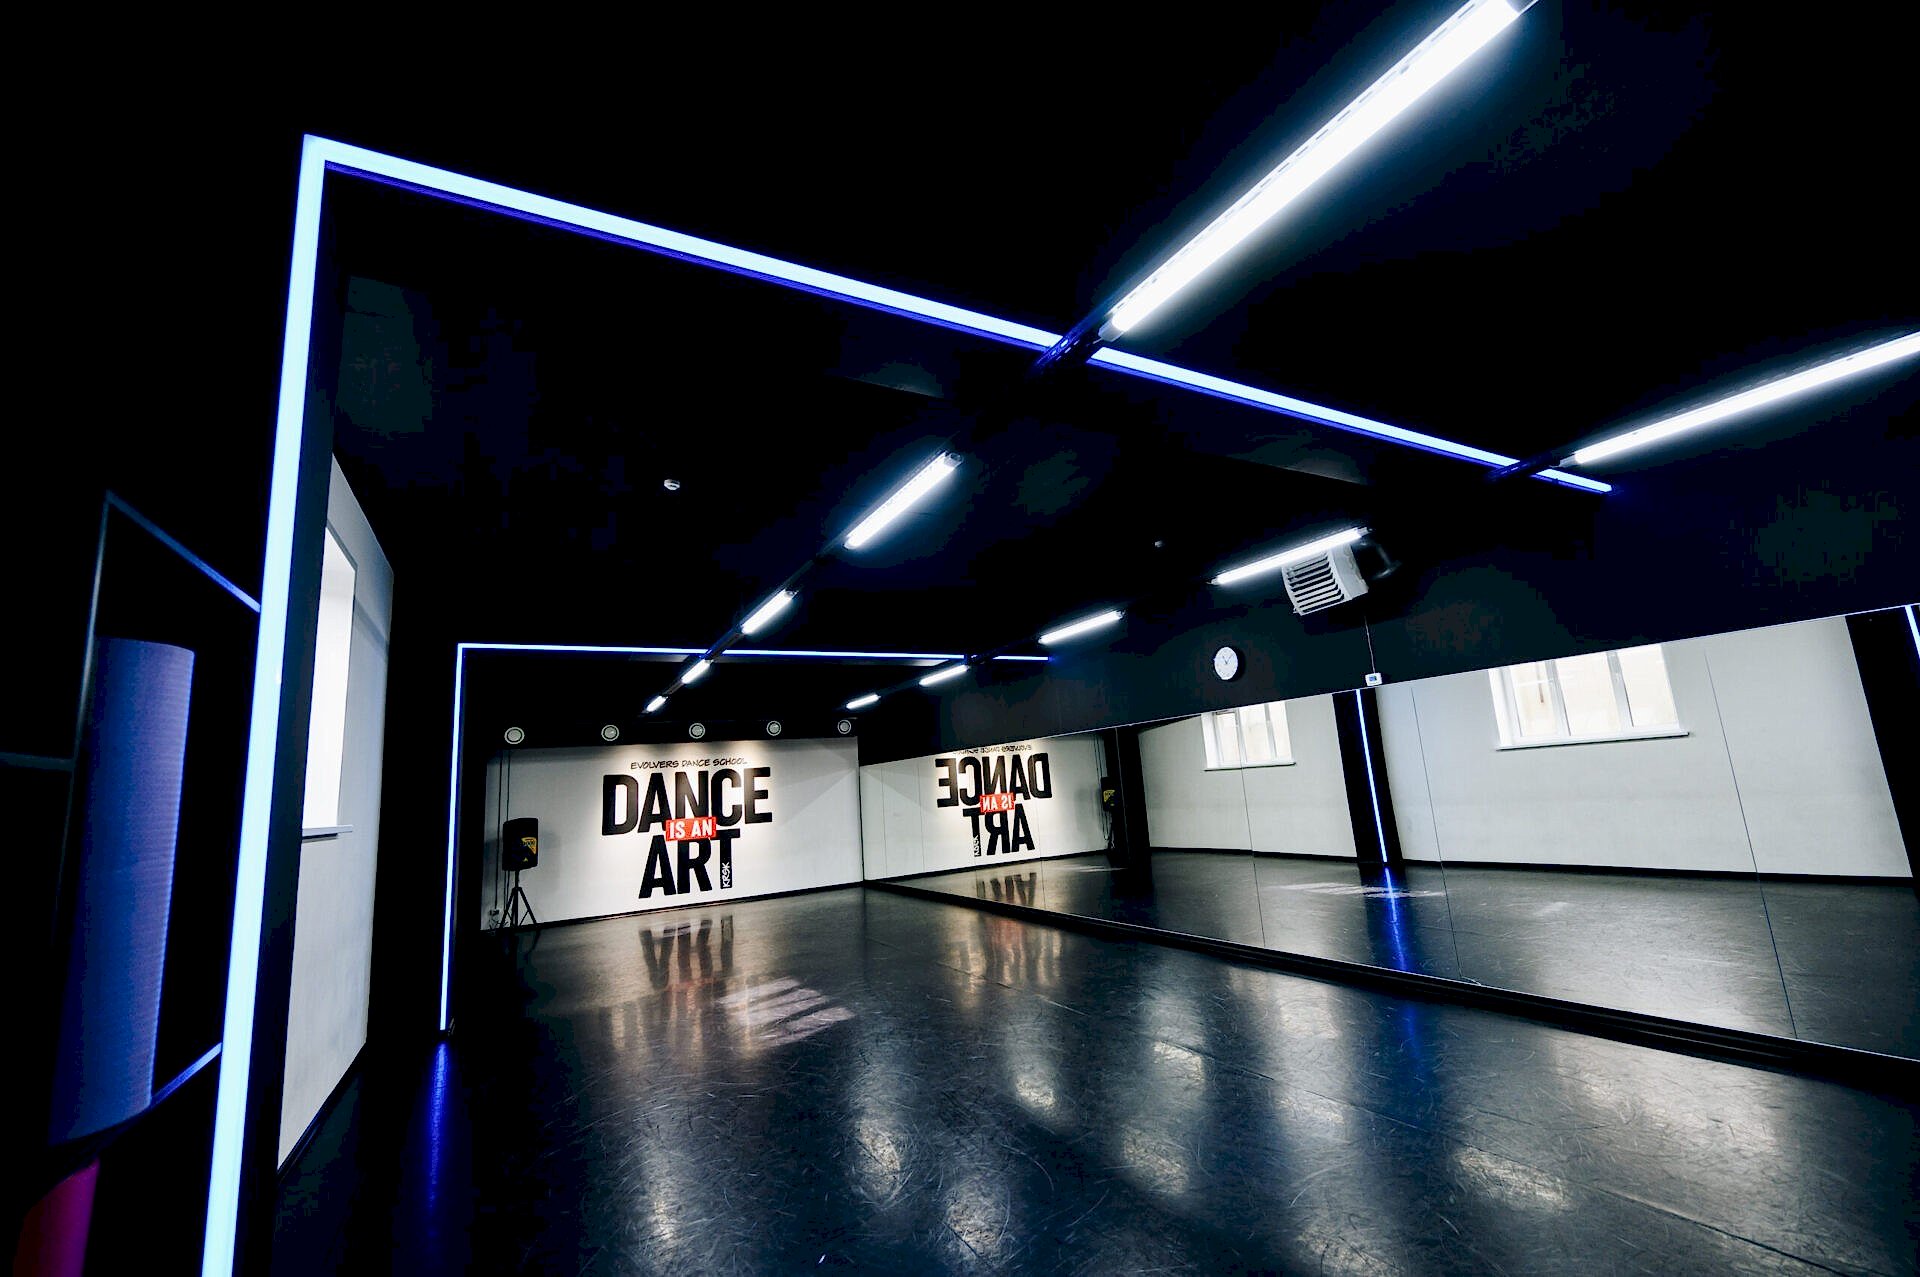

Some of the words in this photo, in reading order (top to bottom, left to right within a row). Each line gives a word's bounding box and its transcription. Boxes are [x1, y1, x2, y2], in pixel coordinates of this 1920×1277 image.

[630, 760, 679, 769] EVOLVERS
[682, 759, 711, 767] DANCE
[713, 757, 747, 766] SCHOOL
[602, 766, 773, 836] DANCE
[669, 821, 686, 840] IS
[691, 819, 713, 838] AN
[638, 828, 741, 900] ART
[721, 861, 731, 888] KRSK
